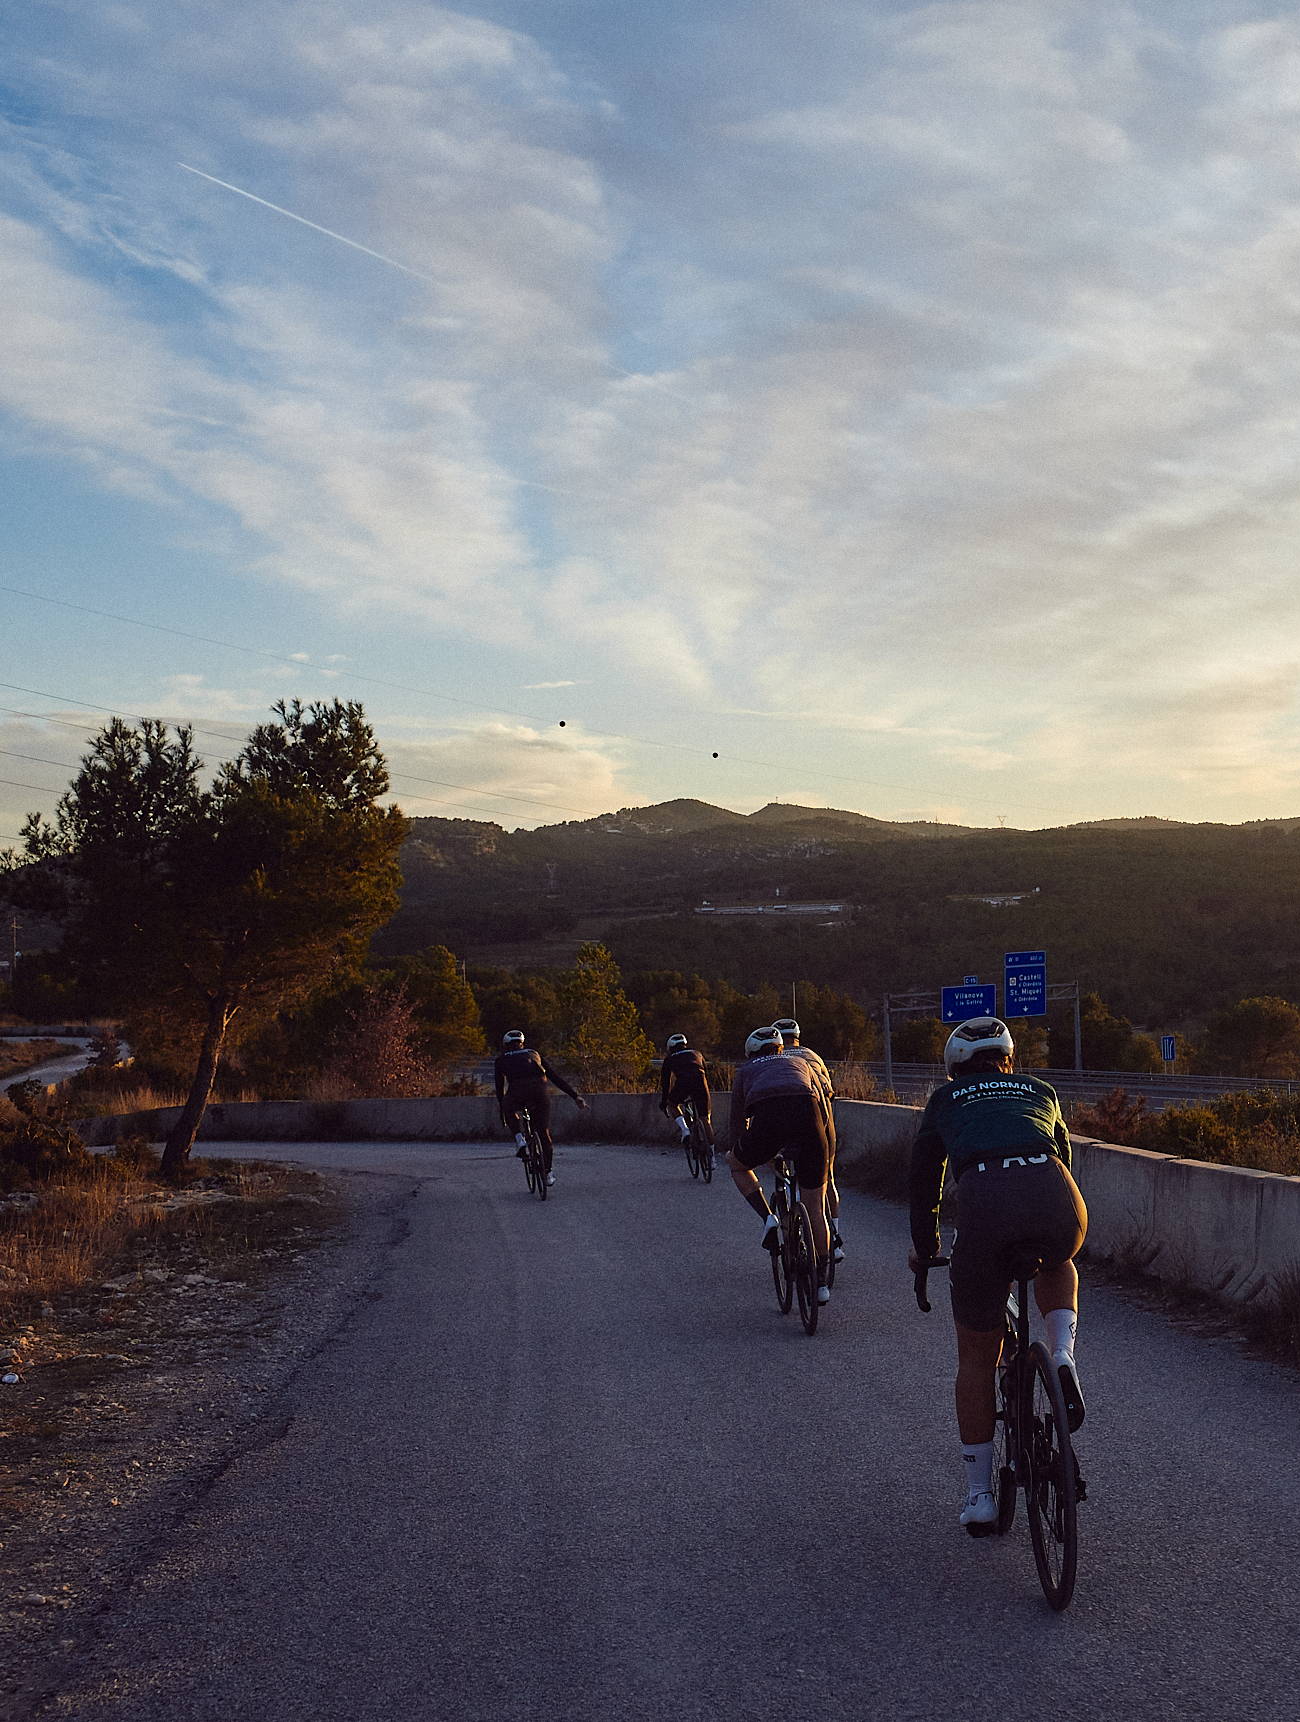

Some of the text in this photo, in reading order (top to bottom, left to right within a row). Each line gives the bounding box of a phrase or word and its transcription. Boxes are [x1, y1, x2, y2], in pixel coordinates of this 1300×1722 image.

[1018, 973, 1041, 981] Castell
[954, 992, 984, 1000] Vilanova
[952, 1081, 1037, 1100] PAS NORMAL
